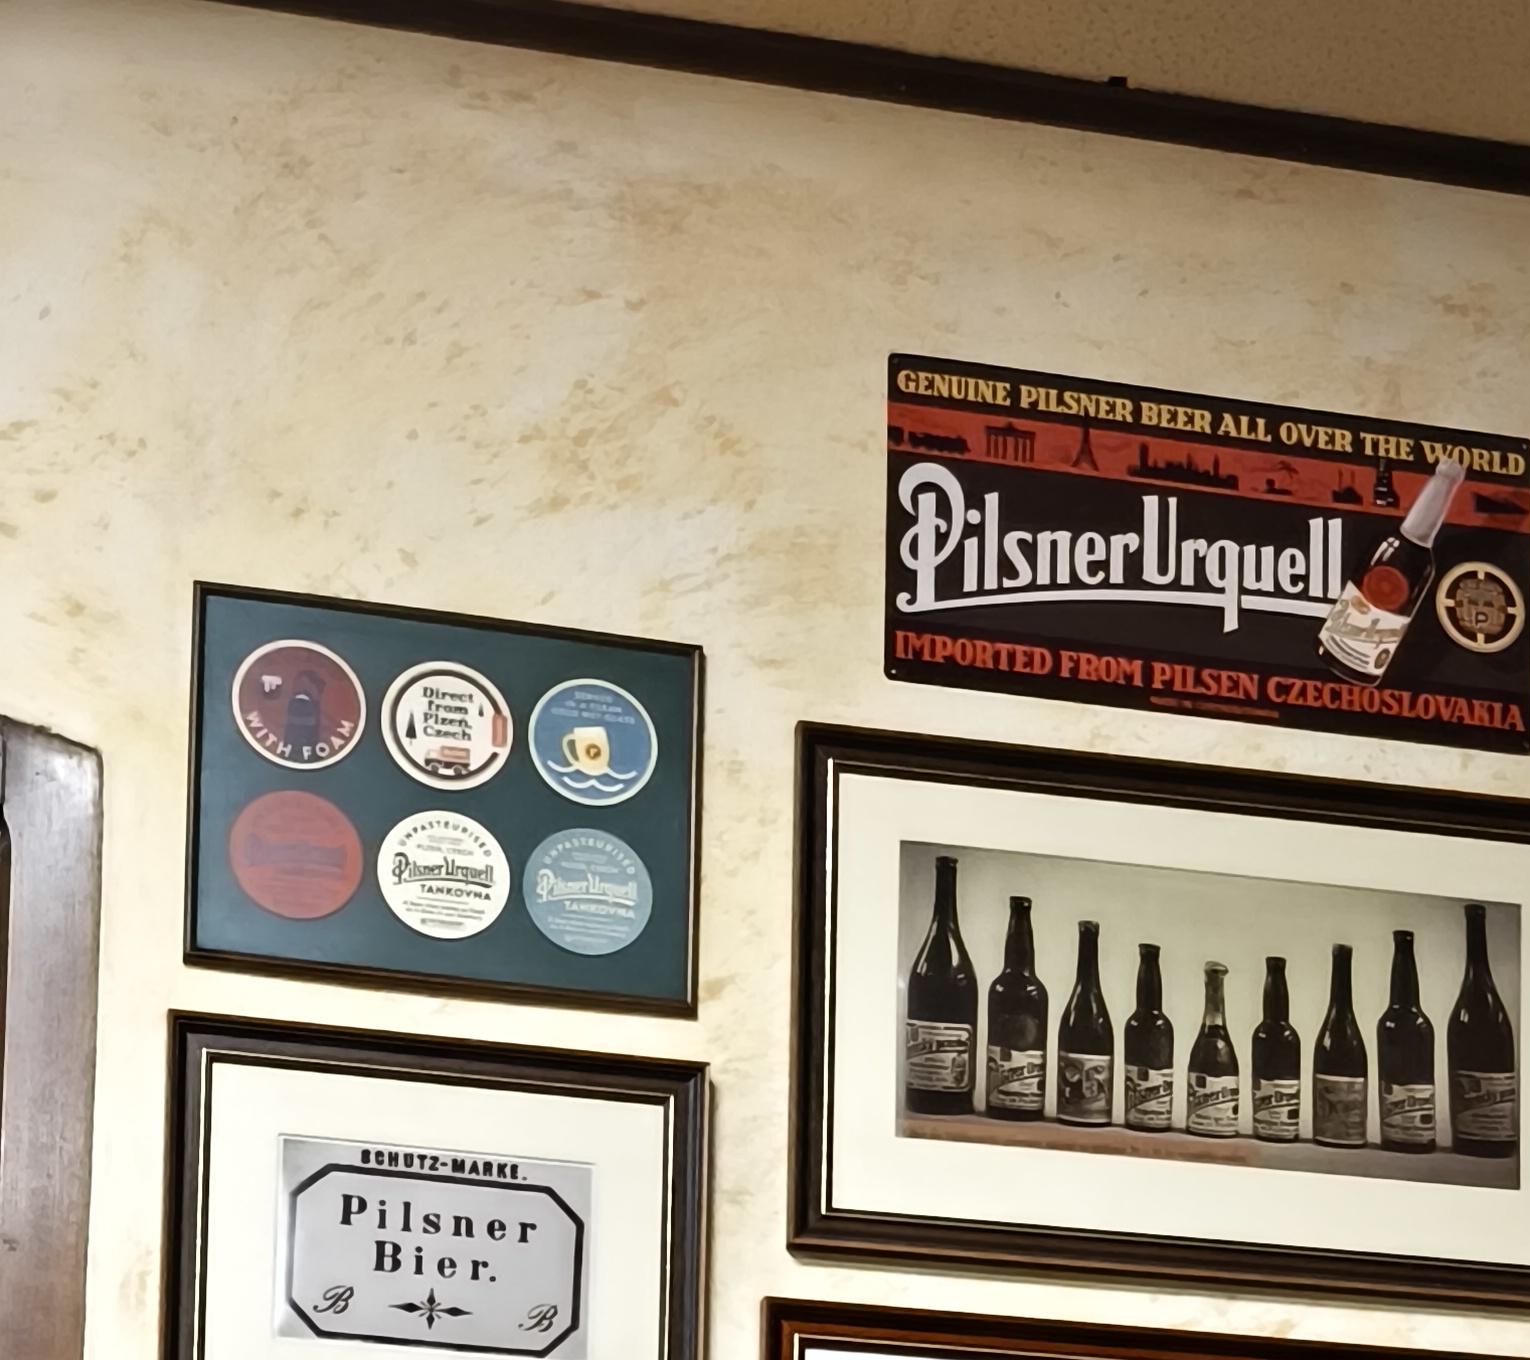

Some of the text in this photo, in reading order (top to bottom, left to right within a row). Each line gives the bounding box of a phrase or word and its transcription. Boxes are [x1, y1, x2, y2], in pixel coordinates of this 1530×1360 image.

[897, 369, 1526, 476] GENUINE PILSNER BEER ALL OVER THE WORLD
[897, 462, 1139, 613] Pilsner
[1142, 495, 1343, 633] Urquell
[422, 686, 474, 703] Direct
[895, 630, 1525, 732] IMPORTED FROM PILSEN CZECHOSLOVAKIA
[427, 700, 469, 715] from
[246, 711, 354, 761] WITH FOAM
[423, 725, 472, 741] Czech
[392, 852, 494, 886] Pilsner Urquell
[420, 884, 491, 900] TANKOVNA
[340, 1194, 537, 1243] Pilsner
[372, 1240, 497, 1282] Bier.
